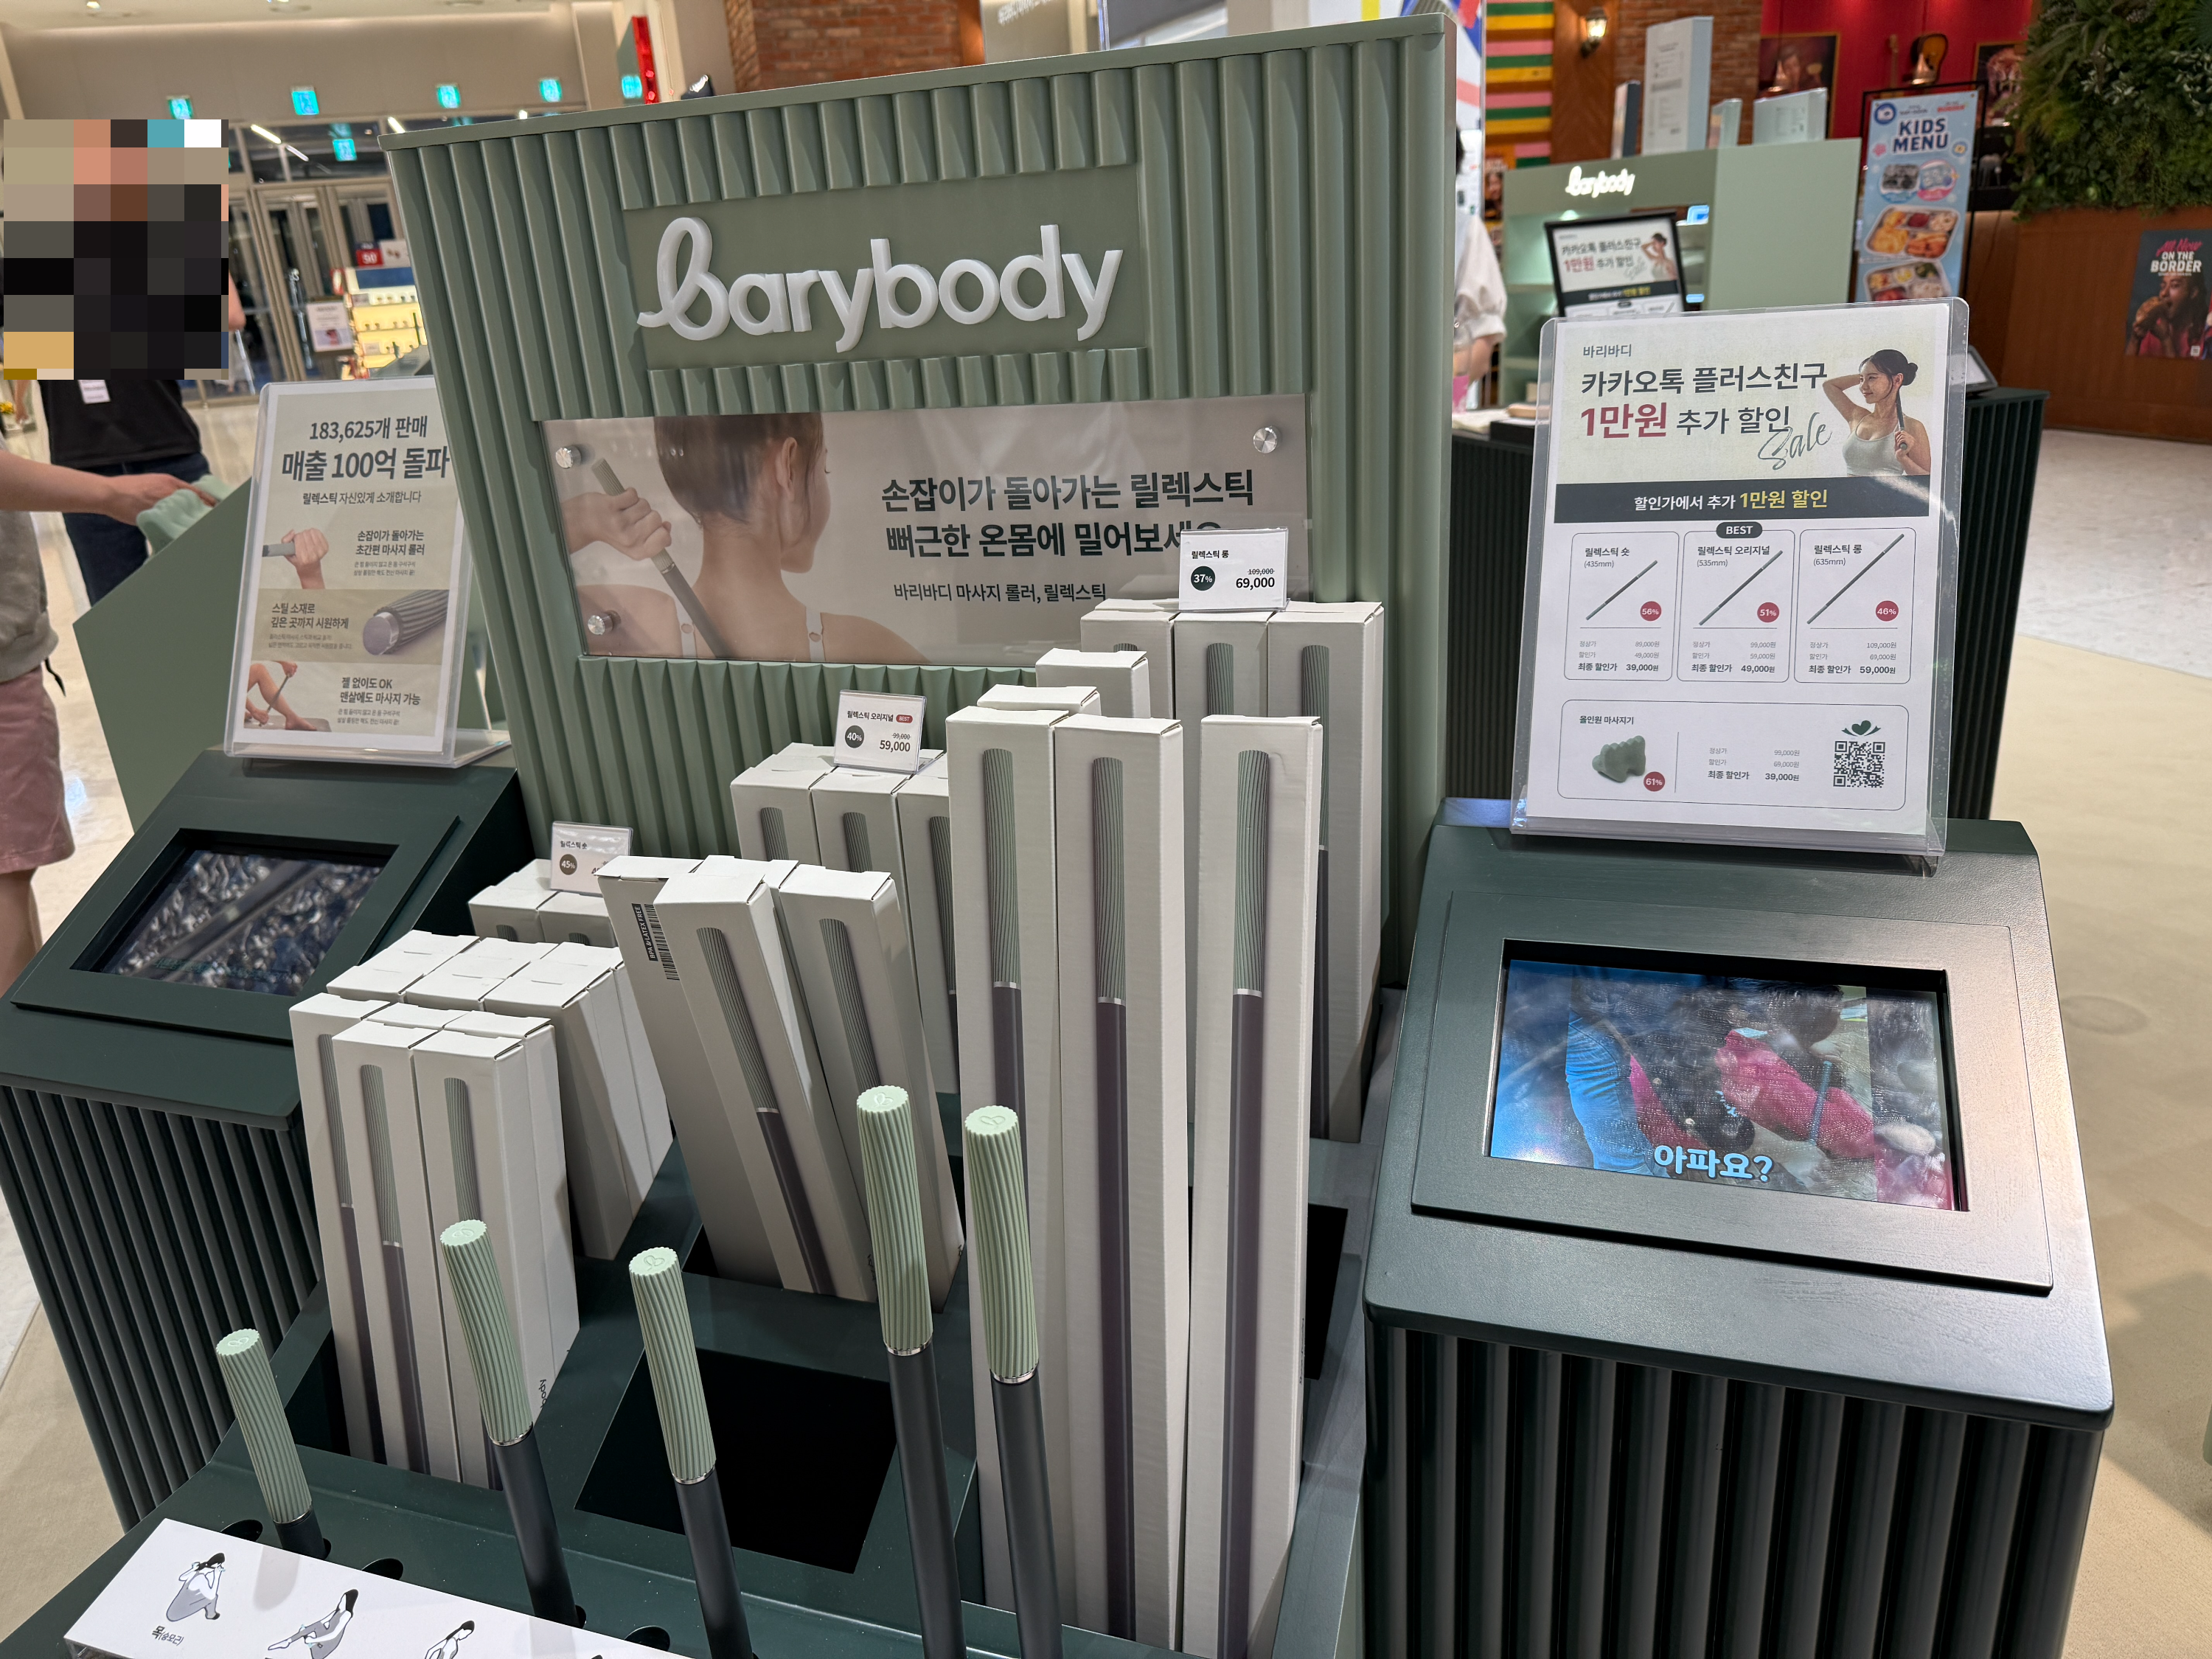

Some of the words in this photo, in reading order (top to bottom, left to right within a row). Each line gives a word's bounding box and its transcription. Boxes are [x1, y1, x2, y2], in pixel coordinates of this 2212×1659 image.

[1899, 119, 1946, 136] KIDS
[1893, 134, 1949, 153] MENU
[2162, 251, 2176, 260] ON
[2177, 251, 2194, 260] THE
[2150, 260, 2202, 273] BORDER
[1583, 344, 1632, 358] 바리바디
[1581, 369, 1685, 397] 카카오톡
[1692, 363, 1828, 393] 플러스친구
[1581, 402, 1667, 439] 1만원
[1676, 408, 1730, 436] 추가
[1738, 406, 1790, 434] 할인
[310, 417, 390, 442] 183,625개
[395, 416, 428, 438] 판매
[1757, 411, 1833, 470] Sale
[282, 450, 327, 481] 매출
[332, 448, 397, 479] 100억
[403, 446, 450, 479] 돌파
[881, 476, 996, 512] 손잡이가
[1004, 473, 1121, 510] 돌아가는
[1130, 469, 1254, 507] 릴렉스틱
[303, 493, 337, 504] 릴렉스틱
[338, 491, 375, 504] 자신있게
[376, 490, 422, 504] 소개합니다
[1634, 496, 1704, 512] 할인가에서
[1707, 495, 1736, 510] 추가
[1740, 490, 1786, 509] 1만원
[1791, 490, 1829, 509] 할인
[357, 530, 390, 541] 손잡이가
[392, 530, 424, 541] 돌아가는
[1726, 526, 1753, 535] BEST
[886, 524, 970, 558] 뻐근한
[978, 522, 1065, 557] 온몸에
[1075, 521, 1222, 556] 밀어보세
[356, 544, 380, 555] 초간편
[382, 544, 406, 555] 마사지
[408, 543, 425, 555] 롤러
[1192, 550, 1220, 559] 릴렉스틱
[1222, 550, 1229, 558] 롱
[1585, 548, 1618, 557] 릴렉스틱
[1621, 548, 1630, 557] 숏
[1697, 546, 1732, 555] 릴렉스틱
[1734, 546, 1770, 555] 오리지널
[1814, 545, 1850, 554] 릴렉스틱
[1853, 545, 1863, 554] 롱
[1697, 559, 1728, 567] (535mm)
[1813, 557, 1846, 566] (635mm)
[1194, 574, 1213, 583] 37%
[1236, 577, 1275, 590] 69,000
[894, 584, 952, 602] 바리바디
[956, 584, 1001, 602] 마사지
[1005, 584, 1041, 604] 롤러,
[1043, 583, 1106, 602] 릴렉스틱
[272, 603, 289, 614] 스틸
[291, 603, 315, 614] 소재로
[271, 617, 288, 629] 깊은
[289, 617, 313, 629] 곳까지
[316, 617, 349, 630] 시원하게
[1578, 663, 1593, 671] 최종
[1595, 663, 1618, 671] 할인가
[1691, 664, 1707, 672] 최종
[1709, 664, 1732, 672] 할인가
[1741, 665, 1775, 673] 49,000원
[1809, 665, 1825, 673] 최종
[1827, 666, 1851, 674] 할인가
[1860, 667, 1896, 675] 59,000원
[341, 677, 350, 689] 젤
[352, 678, 378, 689] 없이도
[379, 679, 392, 689] OK
[340, 692, 374, 703] 맨살에도
[375, 692, 401, 705] 마사지
[403, 694, 421, 706] 가능
[847, 711, 869, 720] 릴렉스틱
[871, 713, 894, 722] 오리지널
[1579, 715, 1602, 725] 올인원
[1604, 716, 1634, 725] 마사지기
[847, 732, 862, 742] 40%
[880, 740, 911, 752] 59,000
[1646, 777, 1663, 786] 61%
[1708, 771, 1724, 779] 최종
[1725, 771, 1750, 780] 할인가
[1765, 773, 1799, 782] 39,000원
[561, 860, 575, 869] 45%
[636, 906, 644, 921] FREE
[639, 922, 650, 939] LATEX
[648, 945, 656, 959] BPA
[1654, 1144, 1774, 1183] 아파요?
